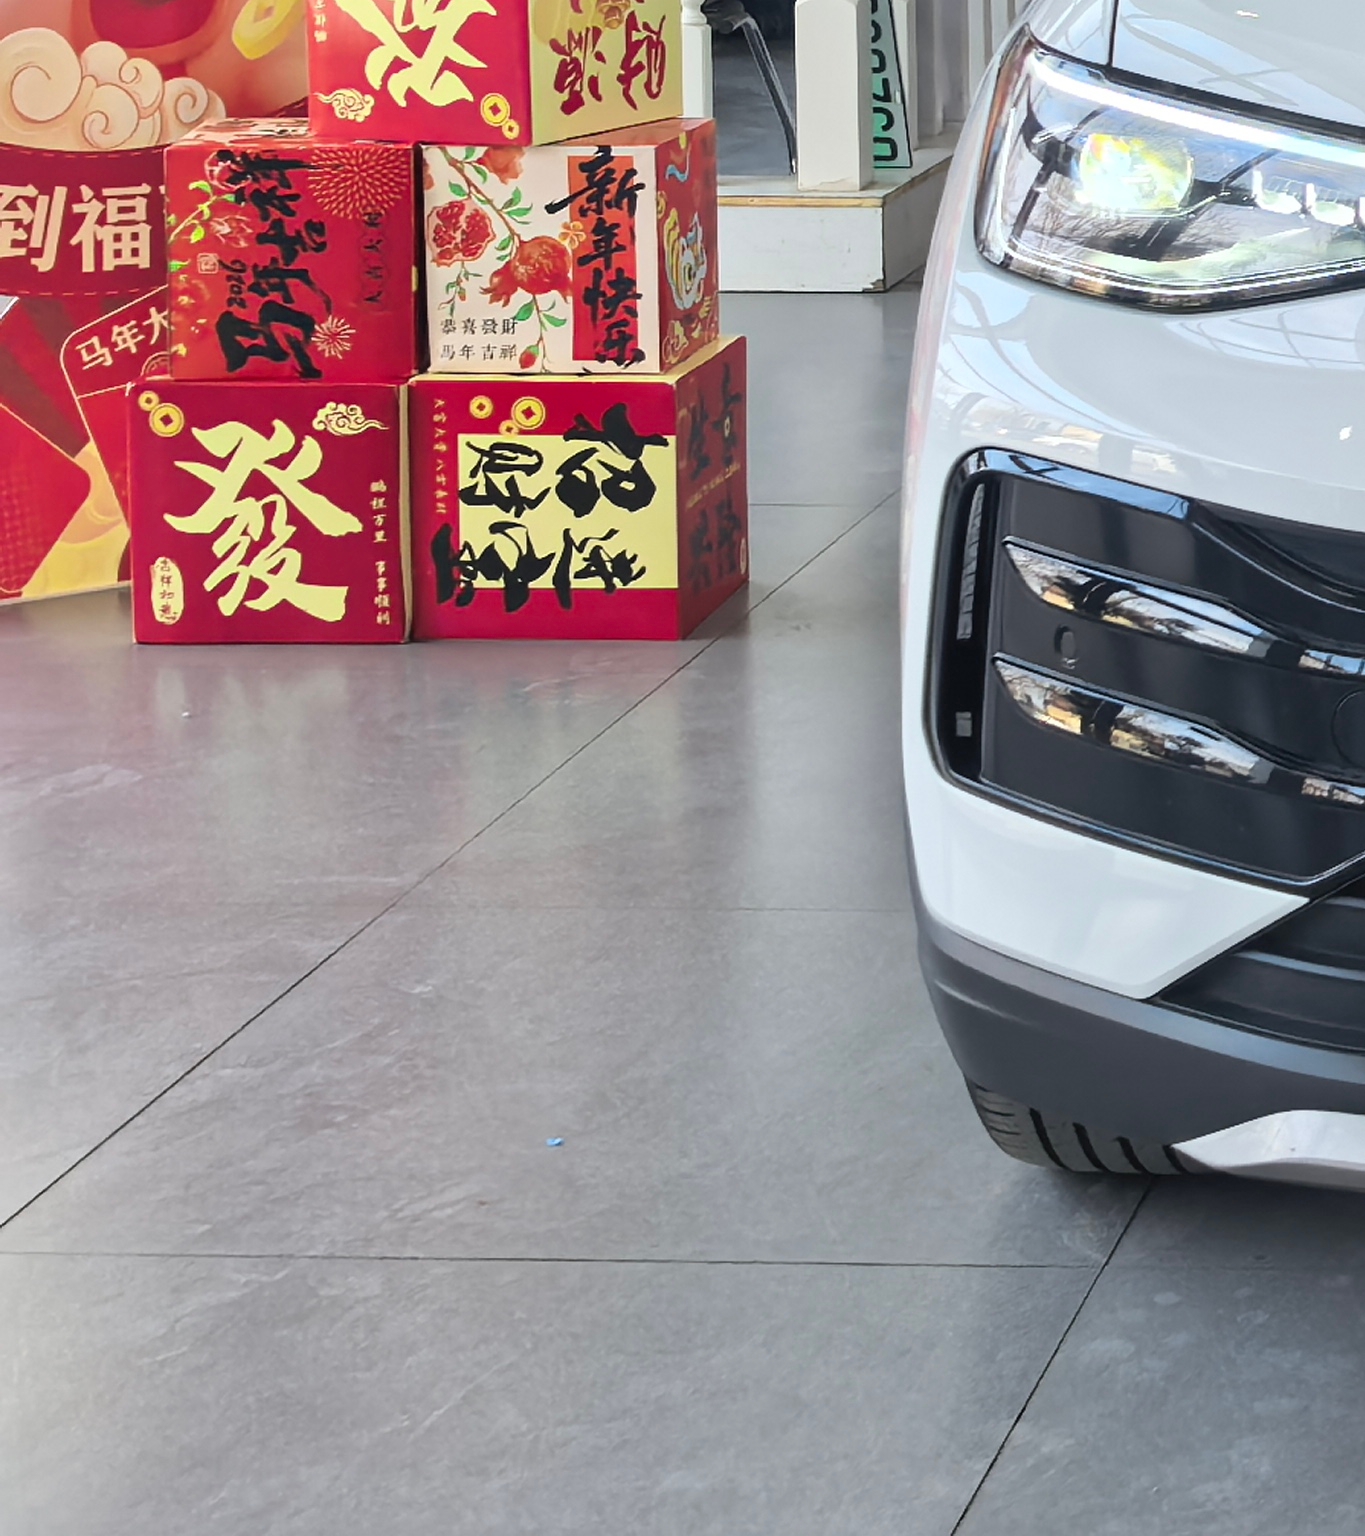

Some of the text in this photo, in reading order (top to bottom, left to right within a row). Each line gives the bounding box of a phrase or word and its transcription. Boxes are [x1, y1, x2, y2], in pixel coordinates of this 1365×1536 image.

[218, 259, 247, 309] 2026
[544, 145, 647, 369] 新年快乐
